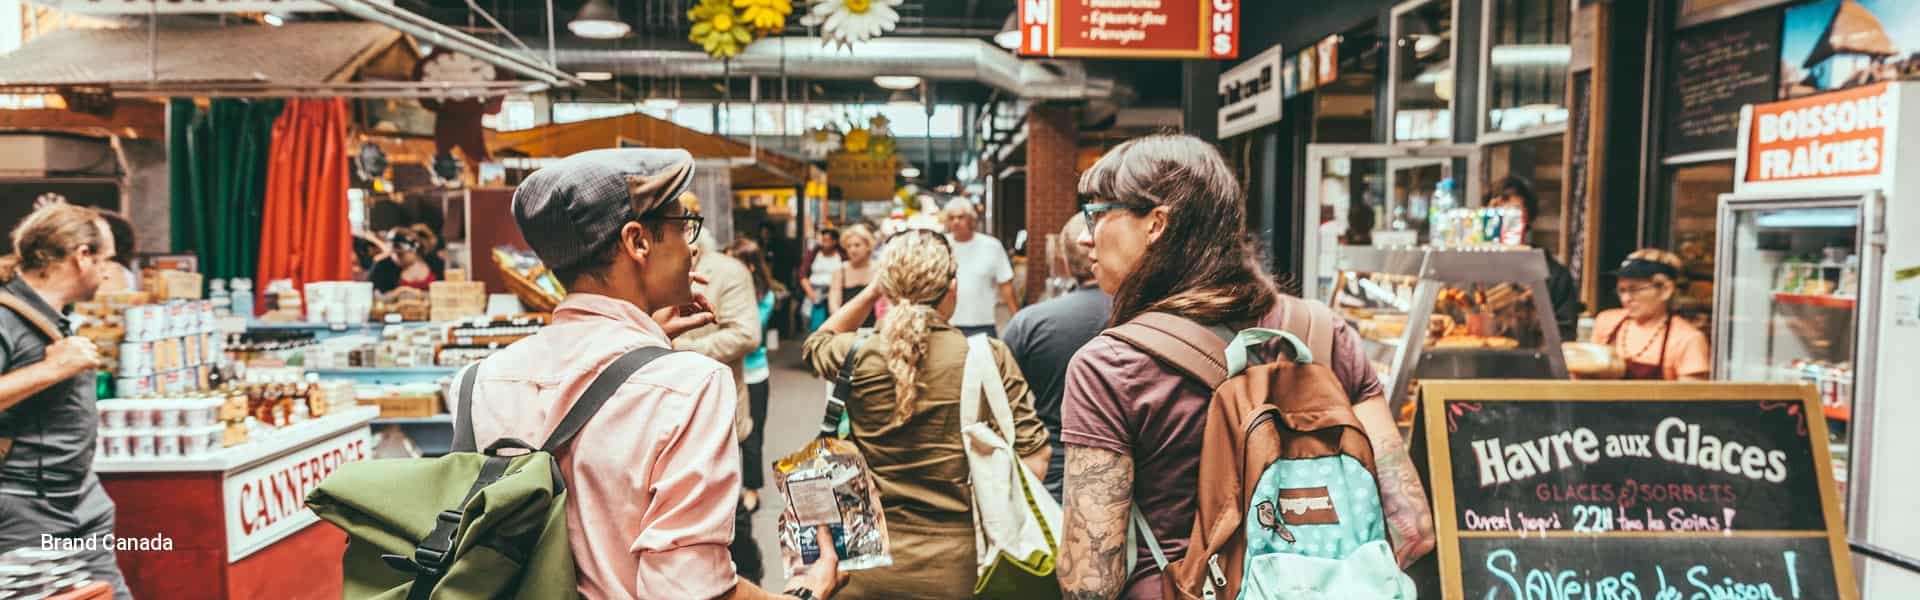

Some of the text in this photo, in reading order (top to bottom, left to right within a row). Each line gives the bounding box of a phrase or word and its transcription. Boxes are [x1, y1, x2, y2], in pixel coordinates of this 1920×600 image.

[1759, 94, 1889, 143] BOISSONS
[1472, 416, 1787, 486] Havre aux Glaces
[1535, 483, 1615, 503] GLACES
[1640, 484, 1737, 503] SORBETS
[1572, 505, 1614, 532] 22H
